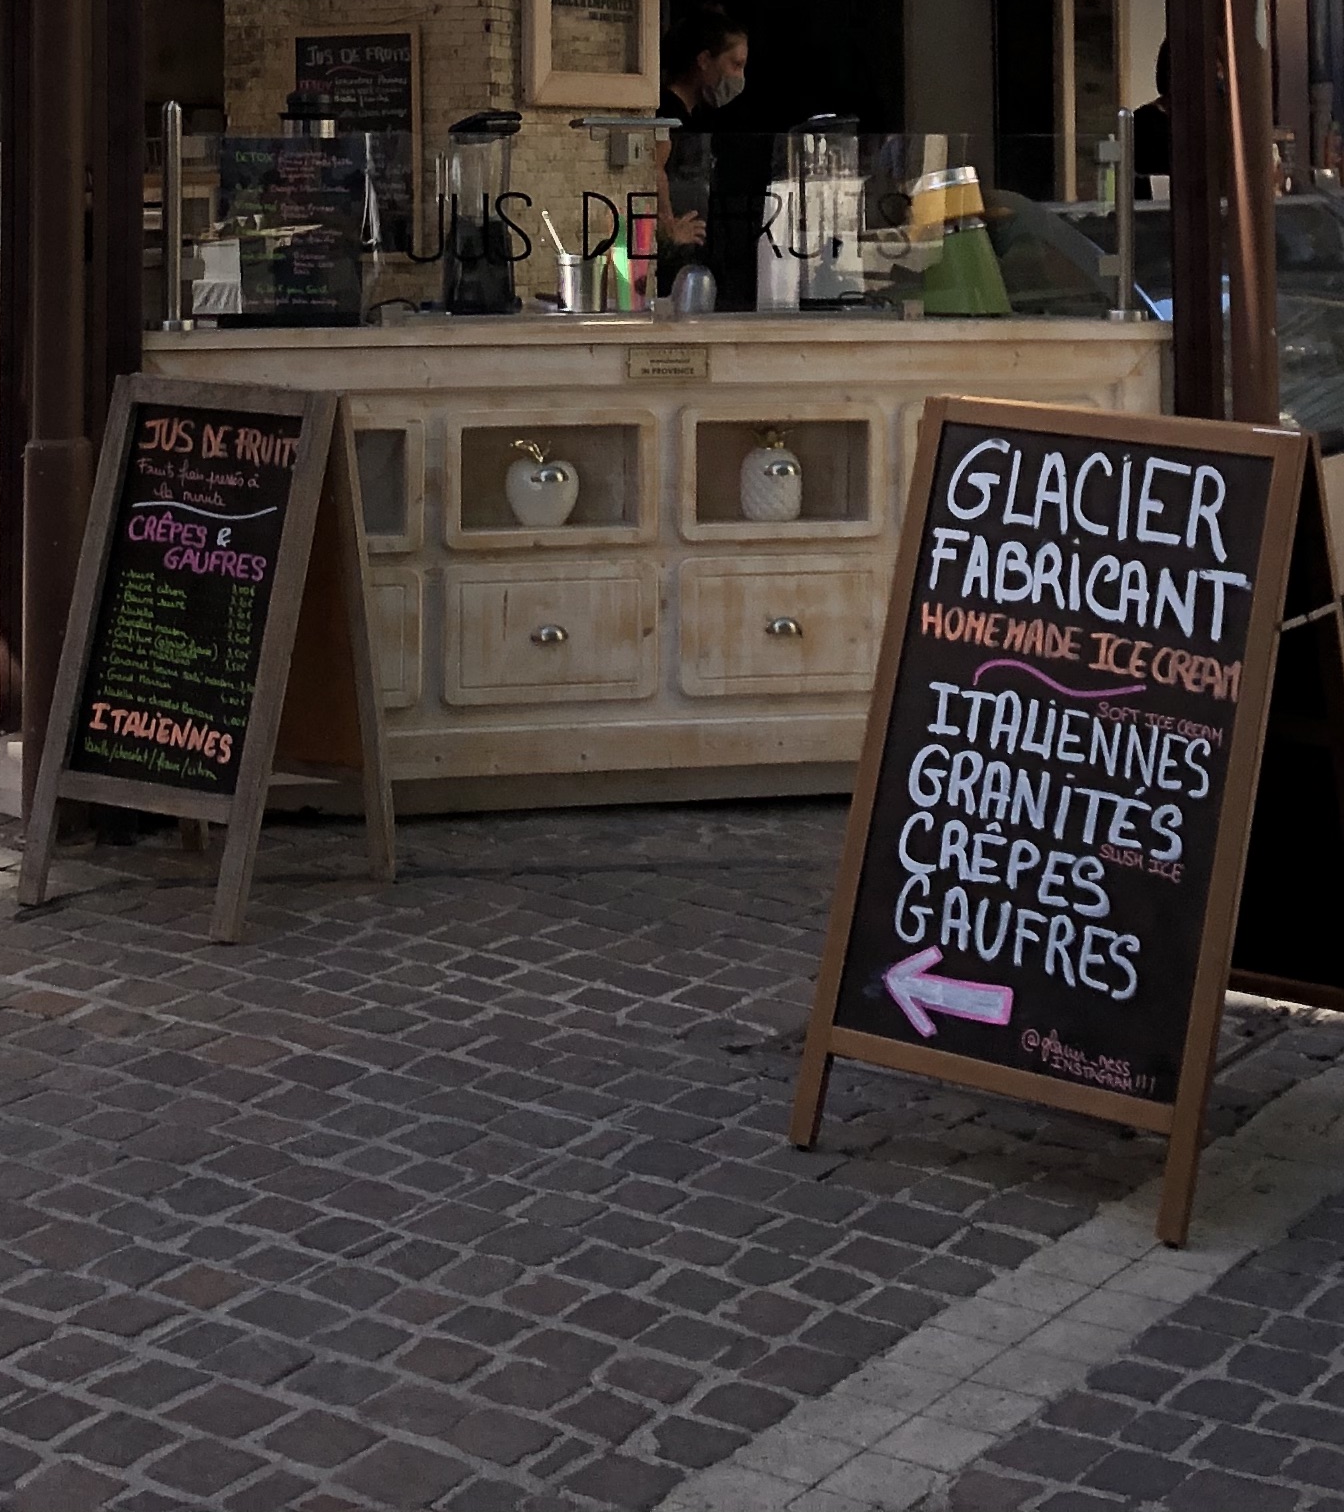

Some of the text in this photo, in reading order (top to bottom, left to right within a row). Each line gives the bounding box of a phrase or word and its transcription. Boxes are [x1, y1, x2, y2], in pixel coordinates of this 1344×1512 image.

[407, 191, 532, 265] JUS
[582, 191, 659, 261] DE
[138, 417, 196, 453] JUS
[201, 423, 234, 460] DE
[128, 511, 209, 549] CRÊPES
[947, 438, 1228, 563] GLACIER
[163, 545, 269, 583] GAUFRES
[929, 526, 1252, 642] FABRICANT
[1087, 631, 1149, 680] ICE
[1151, 644, 1242, 703] CREAM
[88, 701, 234, 765] ITALIENNES
[926, 680, 1212, 799] ITALIENNES
[1097, 700, 1224, 746] SOFT ICE CREAM
[908, 742, 1184, 862] GRANITÉS
[897, 810, 1112, 919] CRÊPES
[1098, 843, 1185, 884] SLUSH ICE
[894, 872, 1141, 1001] GAUFRES
